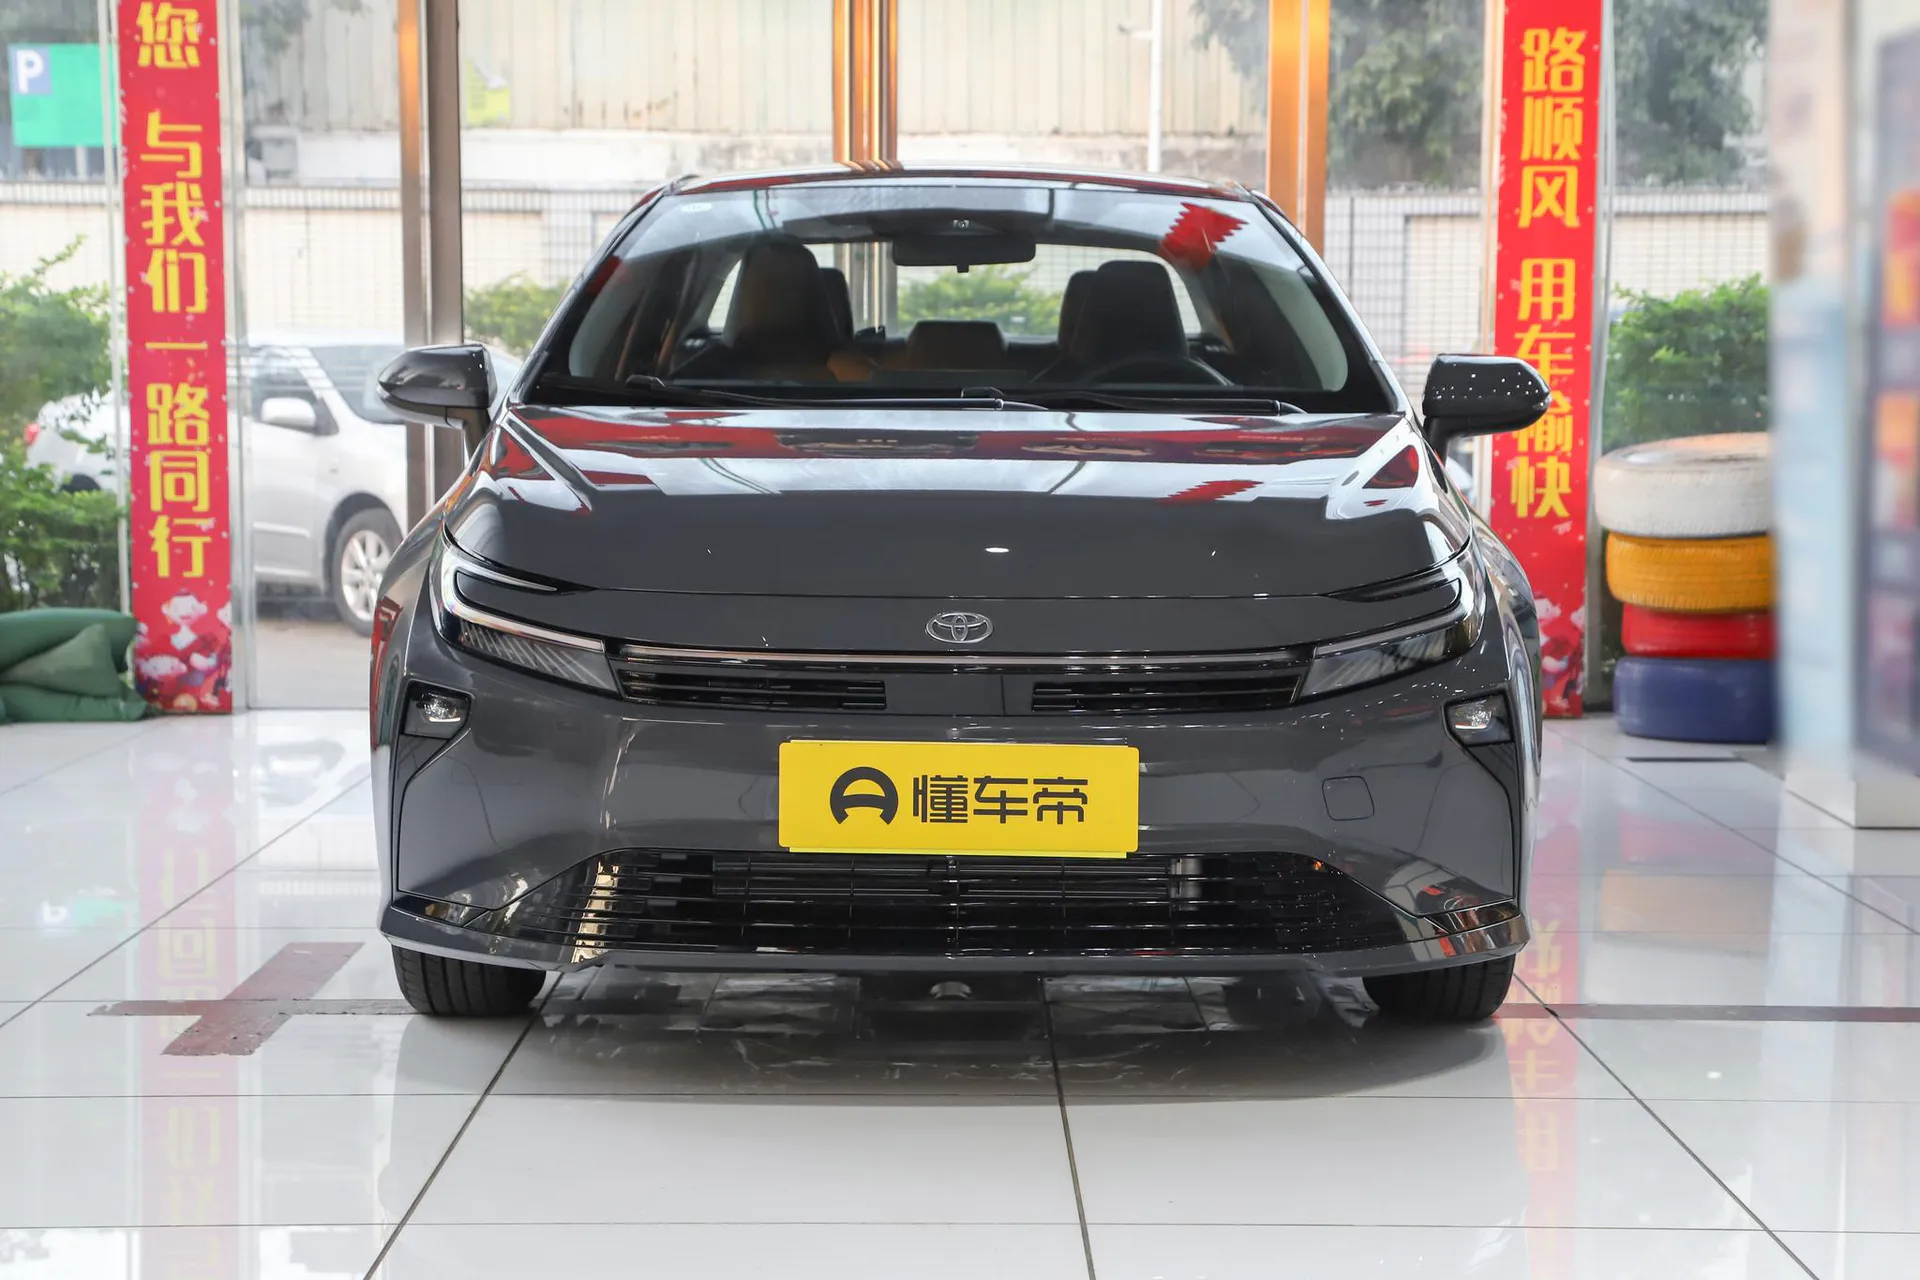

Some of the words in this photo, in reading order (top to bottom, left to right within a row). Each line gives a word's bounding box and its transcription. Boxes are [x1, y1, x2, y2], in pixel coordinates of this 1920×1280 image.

[136, 1, 200, 69] 您
[16, 49, 44, 94] P
[1518, 26, 1586, 229] 路顺风
[140, 110, 212, 578] 与我们一路同行
[913, 774, 1088, 825] 懂车帝
